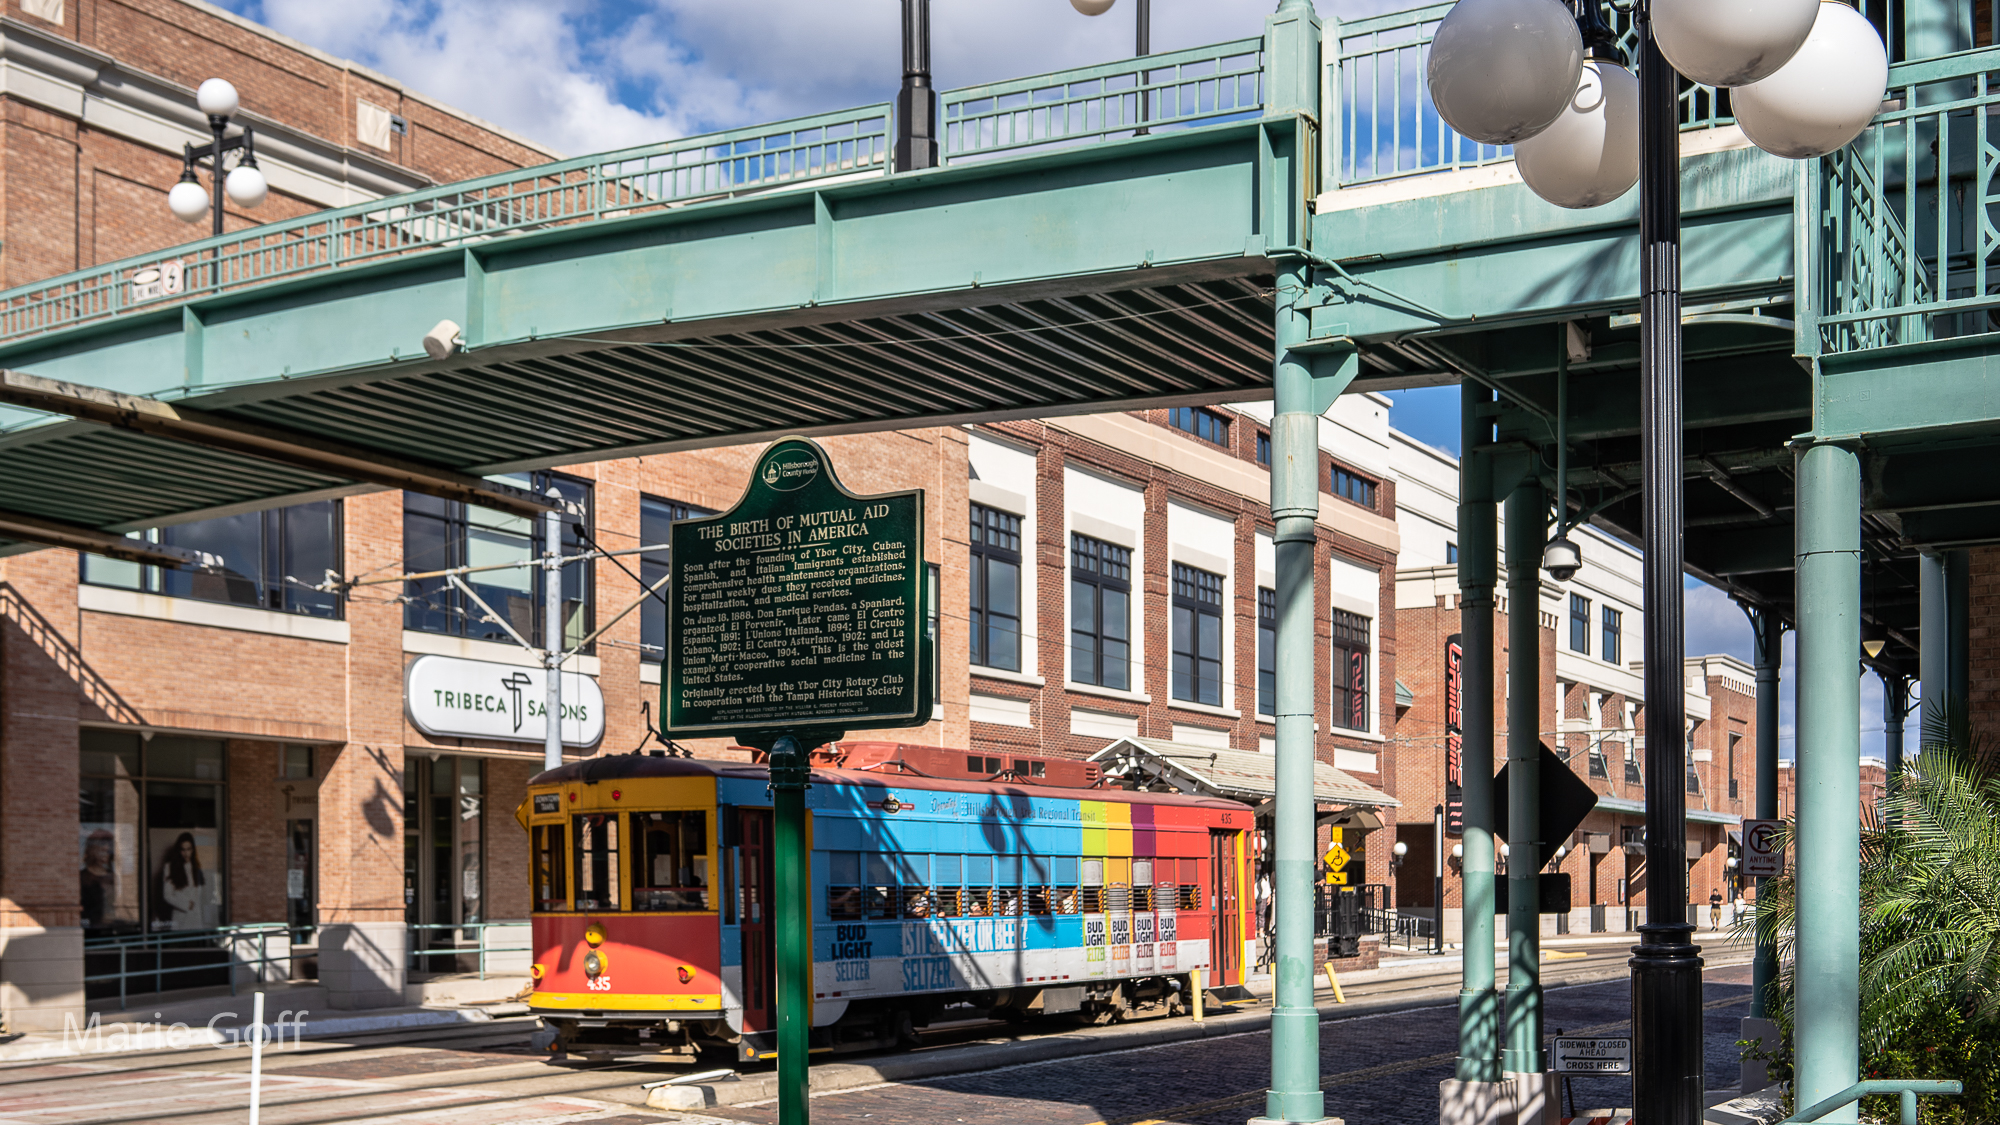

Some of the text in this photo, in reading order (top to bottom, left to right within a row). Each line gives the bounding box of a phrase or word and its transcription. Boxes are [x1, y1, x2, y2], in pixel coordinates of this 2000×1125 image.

[782, 460, 817, 470] Hillsborough
[697, 504, 889, 539] THE BIRTH OF MUTUAL AID
[714, 522, 869, 552] SOCIETIES IN AMERICA
[683, 563, 703, 572] Soon
[708, 560, 730, 569] after
[735, 557, 750, 566] the
[756, 552, 795, 564] founding
[800, 550, 810, 559] of
[815, 548, 837, 558] Ybor
[730, 567, 746, 577] and
[756, 564, 785, 574] Italian
[851, 550, 906, 564] established
[683, 578, 743, 593] comprehensive
[746, 574, 775, 585] health
[778, 570, 835, 582] maintenance
[683, 593, 697, 602] For
[700, 590, 722, 600] small
[726, 587, 756, 598] weekly
[760, 585, 782, 594] dues
[785, 582, 806, 593] they
[810, 577, 851, 589] received
[754, 595, 770, 605] and
[773, 591, 809, 603] medical
[812, 589, 852, 599] services.
[682, 616, 695, 625] On
[697, 615, 716, 624] June
[757, 610, 774, 618] Don
[776, 606, 810, 617] Enrique
[682, 608, 905, 636] organized El Porvenir. Later came El Centro
[857, 620, 866, 630] El
[869, 618, 905, 629] Circulo
[745, 641, 754, 650] El
[757, 639, 787, 649] Centro
[870, 629, 889, 639] and
[892, 628, 904, 638] La
[777, 648, 800, 657] 1904.
[811, 645, 831, 655] This
[838, 644, 846, 652] is
[852, 642, 869, 651] the
[874, 639, 904, 650] oldest
[682, 650, 904, 676] example of cooperative social medicine in the
[681, 674, 904, 699] Originally erected by the Ybor City Rotary Club
[682, 673, 743, 685] United States.
[434, 690, 587, 721] TRIBECA SAONS
[693, 696, 742, 708] cooperation
[745, 694, 765, 703] with
[768, 693, 783, 702] the
[786, 692, 814, 702] Tampa
[818, 687, 863, 699] Historical
[866, 685, 903, 696] Society
[966, 803, 1096, 824] Hillsborough Area Regional Transit
[1221, 813, 1232, 824] 435
[1750, 856, 1777, 864] ANYTIME
[837, 924, 866, 941] BUD
[1087, 921, 1103, 933] BUD
[1112, 920, 1128, 932] BUD
[1136, 919, 1152, 931] BUD
[1160, 918, 1174, 929] BUD
[978, 919, 994, 951] OR
[1085, 934, 1105, 946] LIGHT
[1111, 933, 1130, 945] LIGHT
[1135, 931, 1154, 944] LIGHT
[1159, 930, 1176, 942] LIGHT
[831, 942, 872, 960] LIGHT
[836, 960, 870, 982] SELTZER
[902, 957, 955, 991] SELTZER.
[586, 976, 611, 991] 435
[1598, 1041, 1626, 1049] CLOSED
[1566, 1062, 1620, 1070] CROSS HERE
